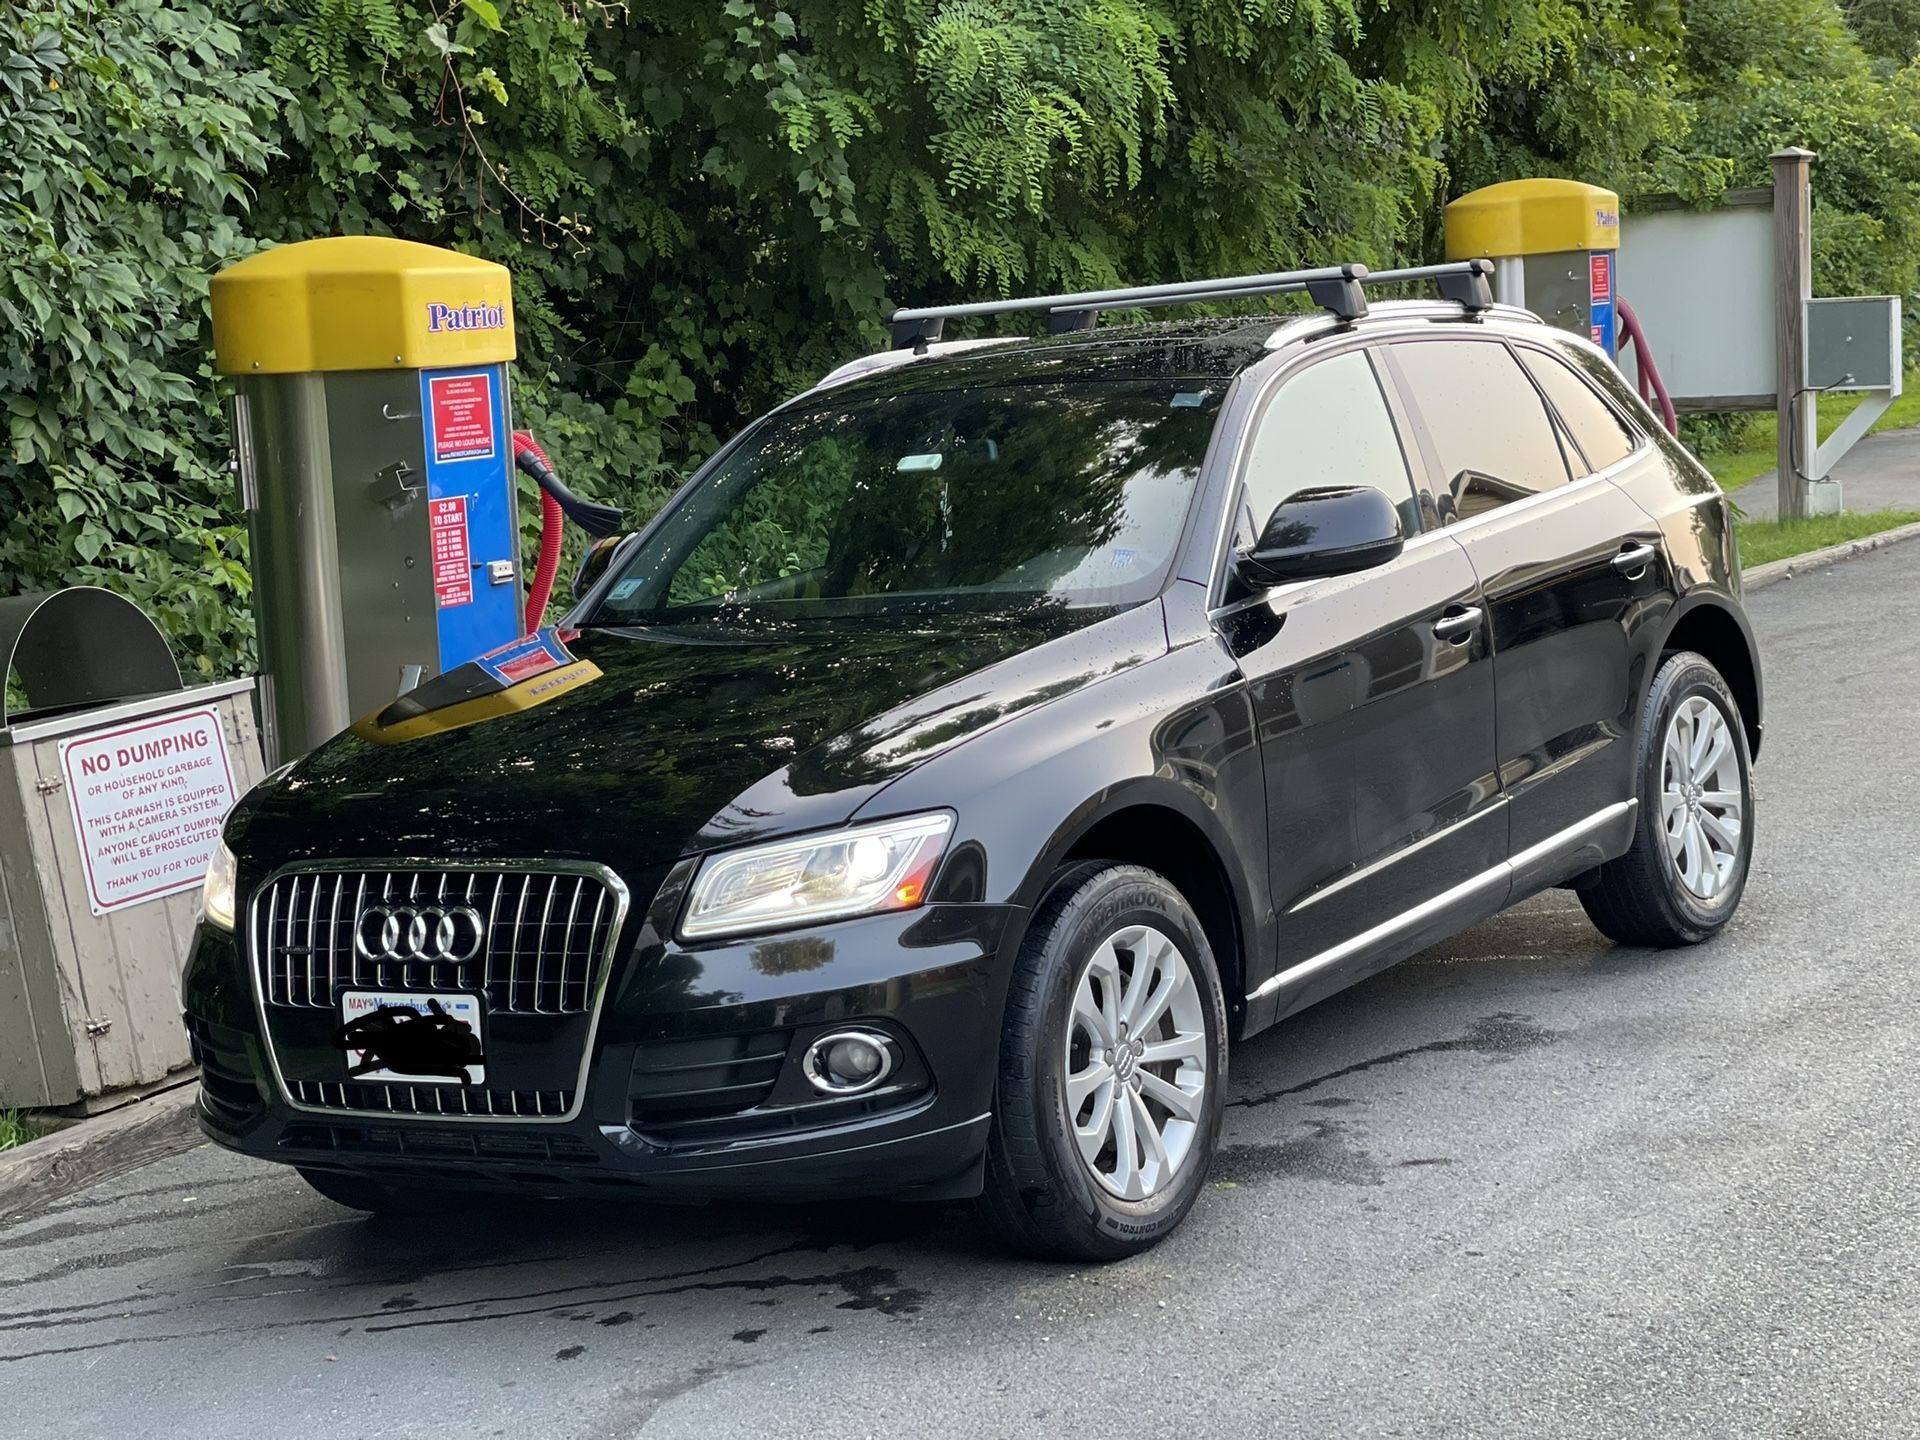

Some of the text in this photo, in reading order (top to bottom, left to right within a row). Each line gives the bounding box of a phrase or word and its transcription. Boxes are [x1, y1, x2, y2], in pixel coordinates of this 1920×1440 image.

[427, 300, 504, 332] Patriot
[434, 512, 463, 525] TO START
[81, 730, 208, 776] NO DUMPING
[88, 756, 212, 796] OR HOUSEHOLD GARBAGE
[122, 789, 134, 800] OF
[138, 783, 158, 797] ANY
[88, 784, 225, 829] THIS CARWASH IS EQUIPPED
[100, 798, 222, 838] WITH A CAMERA SYSTEM.
[98, 836, 139, 858] ANYONE
[141, 826, 181, 844] CAUGHT
[112, 828, 219, 866] WILL BE PROSECUTED
[106, 852, 209, 890] THANK YOU FOR YOUR
[349, 998, 368, 1009] MAY
[1120, 1222, 1156, 1234] CONTROL
